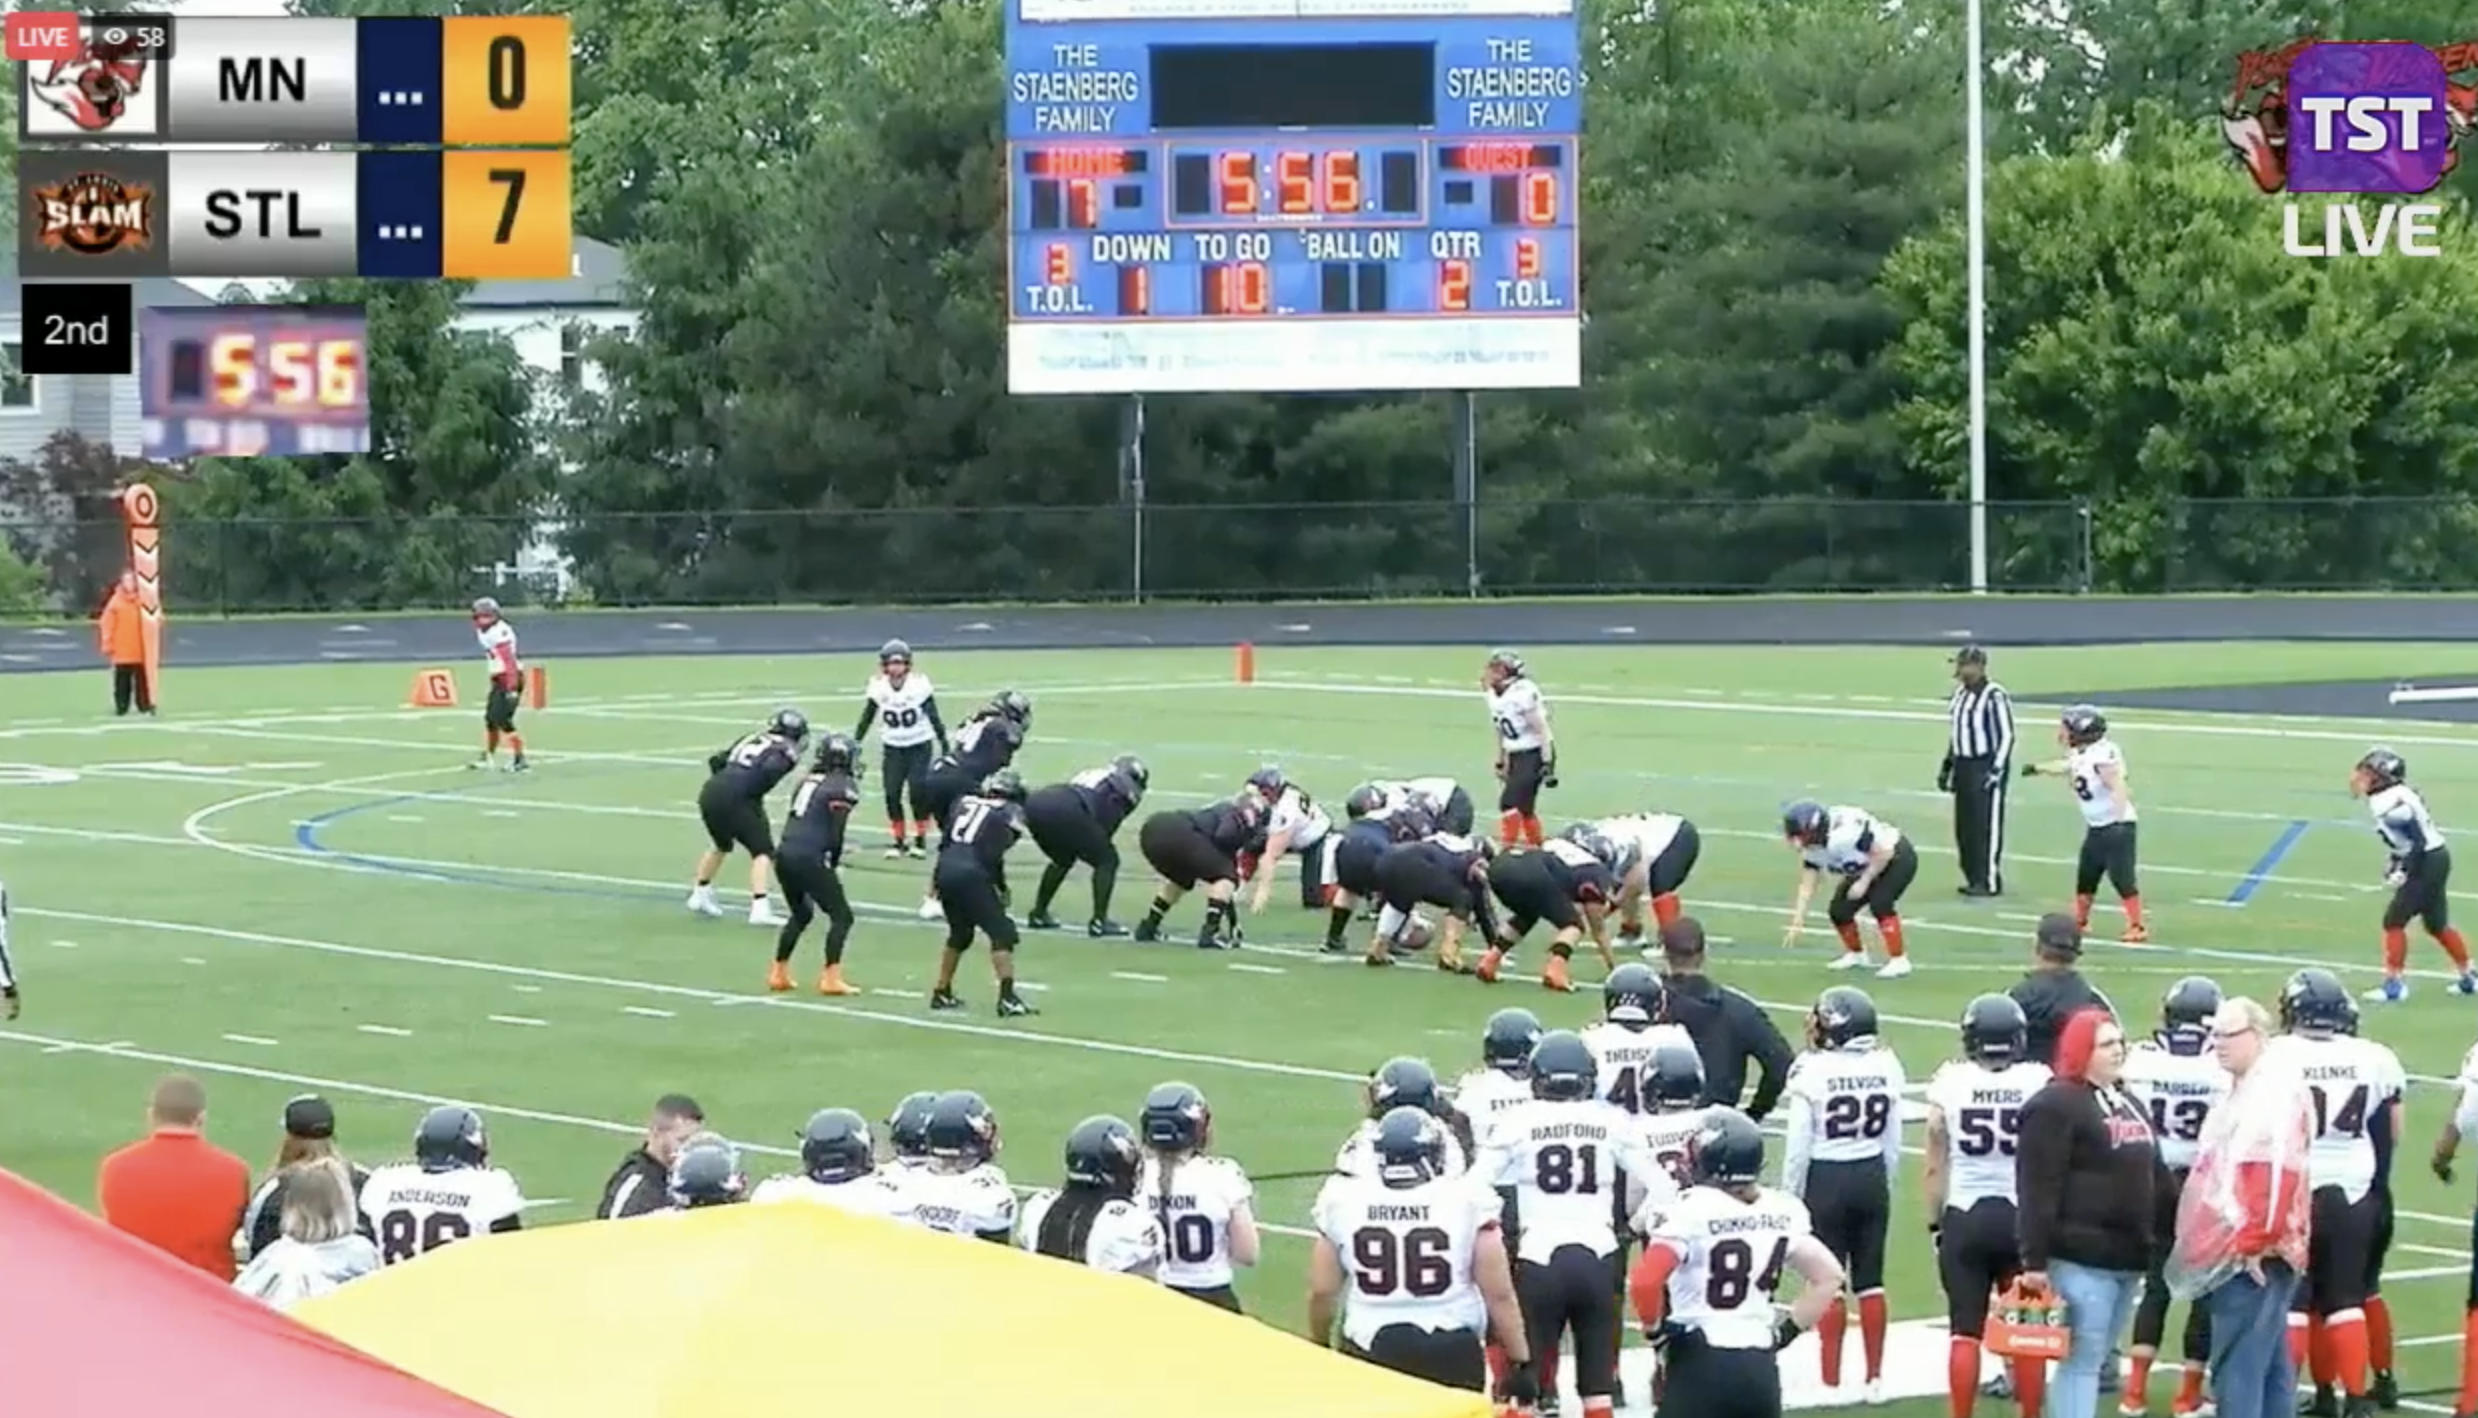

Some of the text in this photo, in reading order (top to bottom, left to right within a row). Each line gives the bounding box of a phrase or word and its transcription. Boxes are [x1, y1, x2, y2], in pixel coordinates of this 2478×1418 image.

[1053, 44, 1098, 67] THE
[1486, 39, 1532, 62] THE
[1013, 71, 1139, 102] STAENBERG
[1447, 67, 1571, 98] STAENBERG
[1035, 106, 1115, 132] FAMILY
[1469, 101, 1549, 128] FAMILY
[1222, 152, 1359, 213] 5:56
[1070, 179, 1095, 226] 7
[1527, 173, 1555, 222] 0
[1093, 233, 1171, 262] DOWN
[1195, 233, 1270, 261] TO GO
[1307, 230, 1400, 260] BALL ON
[1432, 231, 1482, 258] QTR
[1517, 238, 1539, 277] 3
[1049, 243, 1070, 282] 3
[1026, 285, 1094, 312] T.O.L.
[1136, 266, 1147, 313] 1
[1221, 262, 1266, 313] 10
[1443, 261, 1469, 310] 2
[1497, 279, 1563, 307] T.O.L.
[429, 674, 450, 700] G
[1493, 716, 1519, 740] 0
[2303, 1066, 2357, 1080] KLENKE
[1973, 1089, 2023, 1104] MYERS
[1825, 1093, 1890, 1140] 28
[1531, 1124, 1606, 1141] RADFORD
[1536, 1144, 1599, 1194] 81
[389, 1190, 471, 1207] ANDERSON
[1367, 1205, 1430, 1220] BRYANT
[1353, 1226, 1452, 1298] 96
[1706, 1236, 1788, 1310] 84
